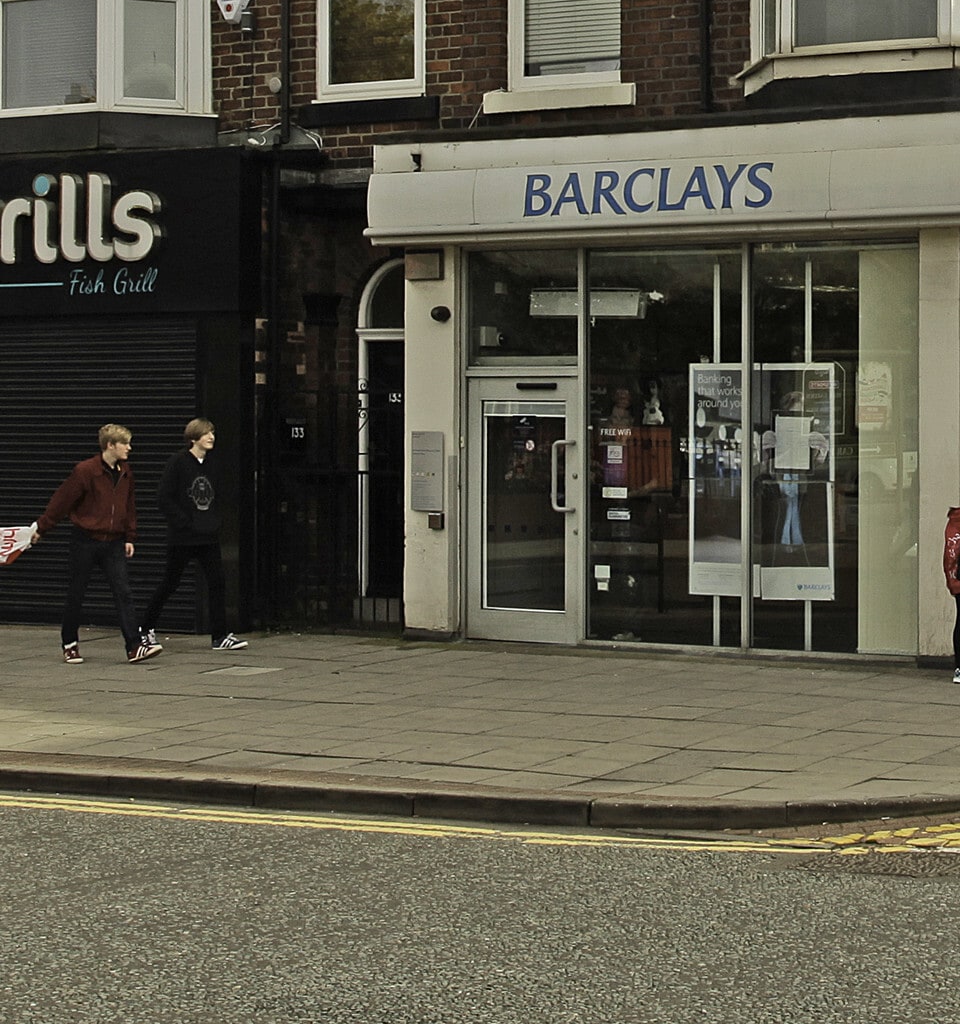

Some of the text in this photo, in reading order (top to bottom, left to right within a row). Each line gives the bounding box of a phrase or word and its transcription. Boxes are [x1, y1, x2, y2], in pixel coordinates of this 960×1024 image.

[523, 162, 774, 217] BARCLAYS
[69, 267, 159, 296] Fish Grill
[697, 374, 732, 386] Banking
[697, 386, 716, 395] that
[697, 397, 729, 407] around
[291, 427, 305, 438] 133
[600, 428, 617, 436] FREE
